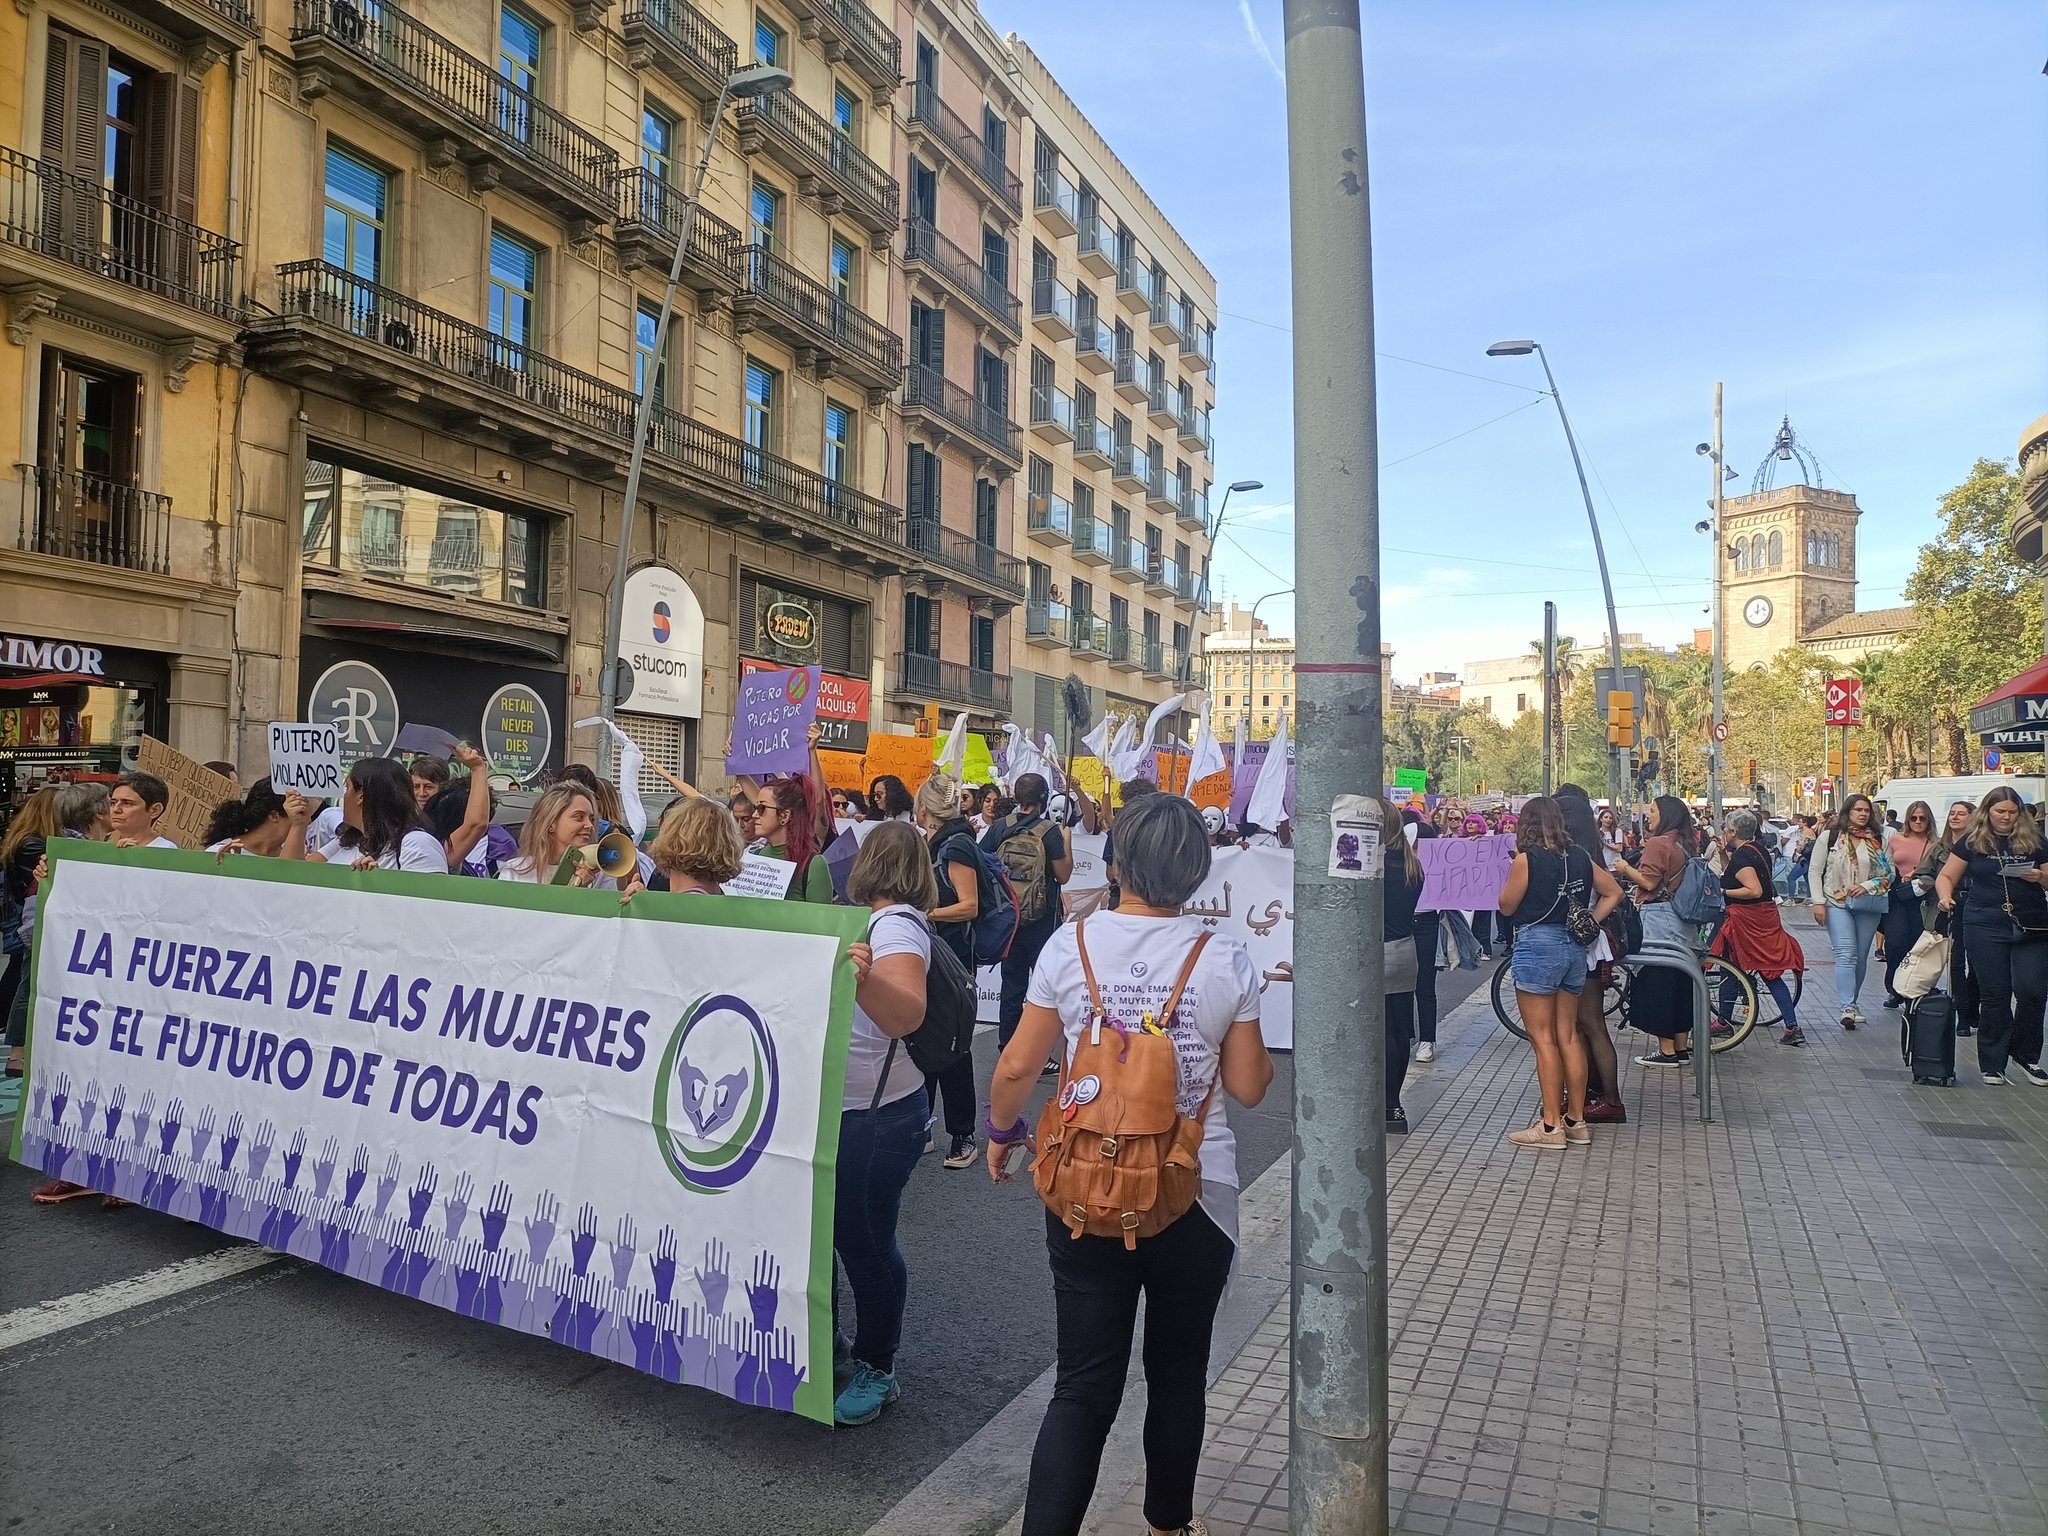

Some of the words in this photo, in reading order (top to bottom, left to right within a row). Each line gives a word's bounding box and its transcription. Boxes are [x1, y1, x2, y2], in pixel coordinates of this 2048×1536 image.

[633, 652, 687, 679] stucom
[745, 686, 782, 708] PUTERO
[817, 680, 843, 697] OCAL
[501, 696, 535, 714] RETAIL
[815, 698, 857, 716] ALQUILER
[501, 717, 534, 734] NEVER
[747, 708, 780, 730] PAGAS
[783, 703, 802, 721] POR
[821, 721, 832, 738] 71
[836, 722, 849, 740] 71
[273, 727, 336, 755] PUTERO
[506, 738, 529, 753] DIES
[745, 727, 790, 759] VIOLAR
[141, 736, 155, 760] EL
[160, 747, 188, 773] LOBBY
[187, 761, 216, 791] QUEER
[217, 781, 233, 797] LA
[271, 762, 340, 790] VIOLADOR
[166, 791, 211, 839] MUJE
[1427, 838, 1467, 869] NO
[760, 865, 781, 874] DECIDEN
[1114, 984, 1145, 994] DONA,
[1148, 985, 1198, 996] EMAKME,
[67, 929, 112, 978] LA
[127, 938, 272, 1005] FUERZA
[287, 960, 342, 1016] DE
[348, 969, 432, 1032] LAS
[438, 984, 651, 1072] MUJERES
[1119, 996, 1155, 1006] MUYER,
[1177, 1044, 1208, 1053] ENYW,
[1182, 1055, 1204, 1064] RAU,
[56, 997, 102, 1046] ES
[109, 1006, 144, 1057] EL
[156, 1014, 313, 1091] FUTURO
[323, 1047, 383, 1106] DE
[389, 1060, 544, 1146] TODAS
